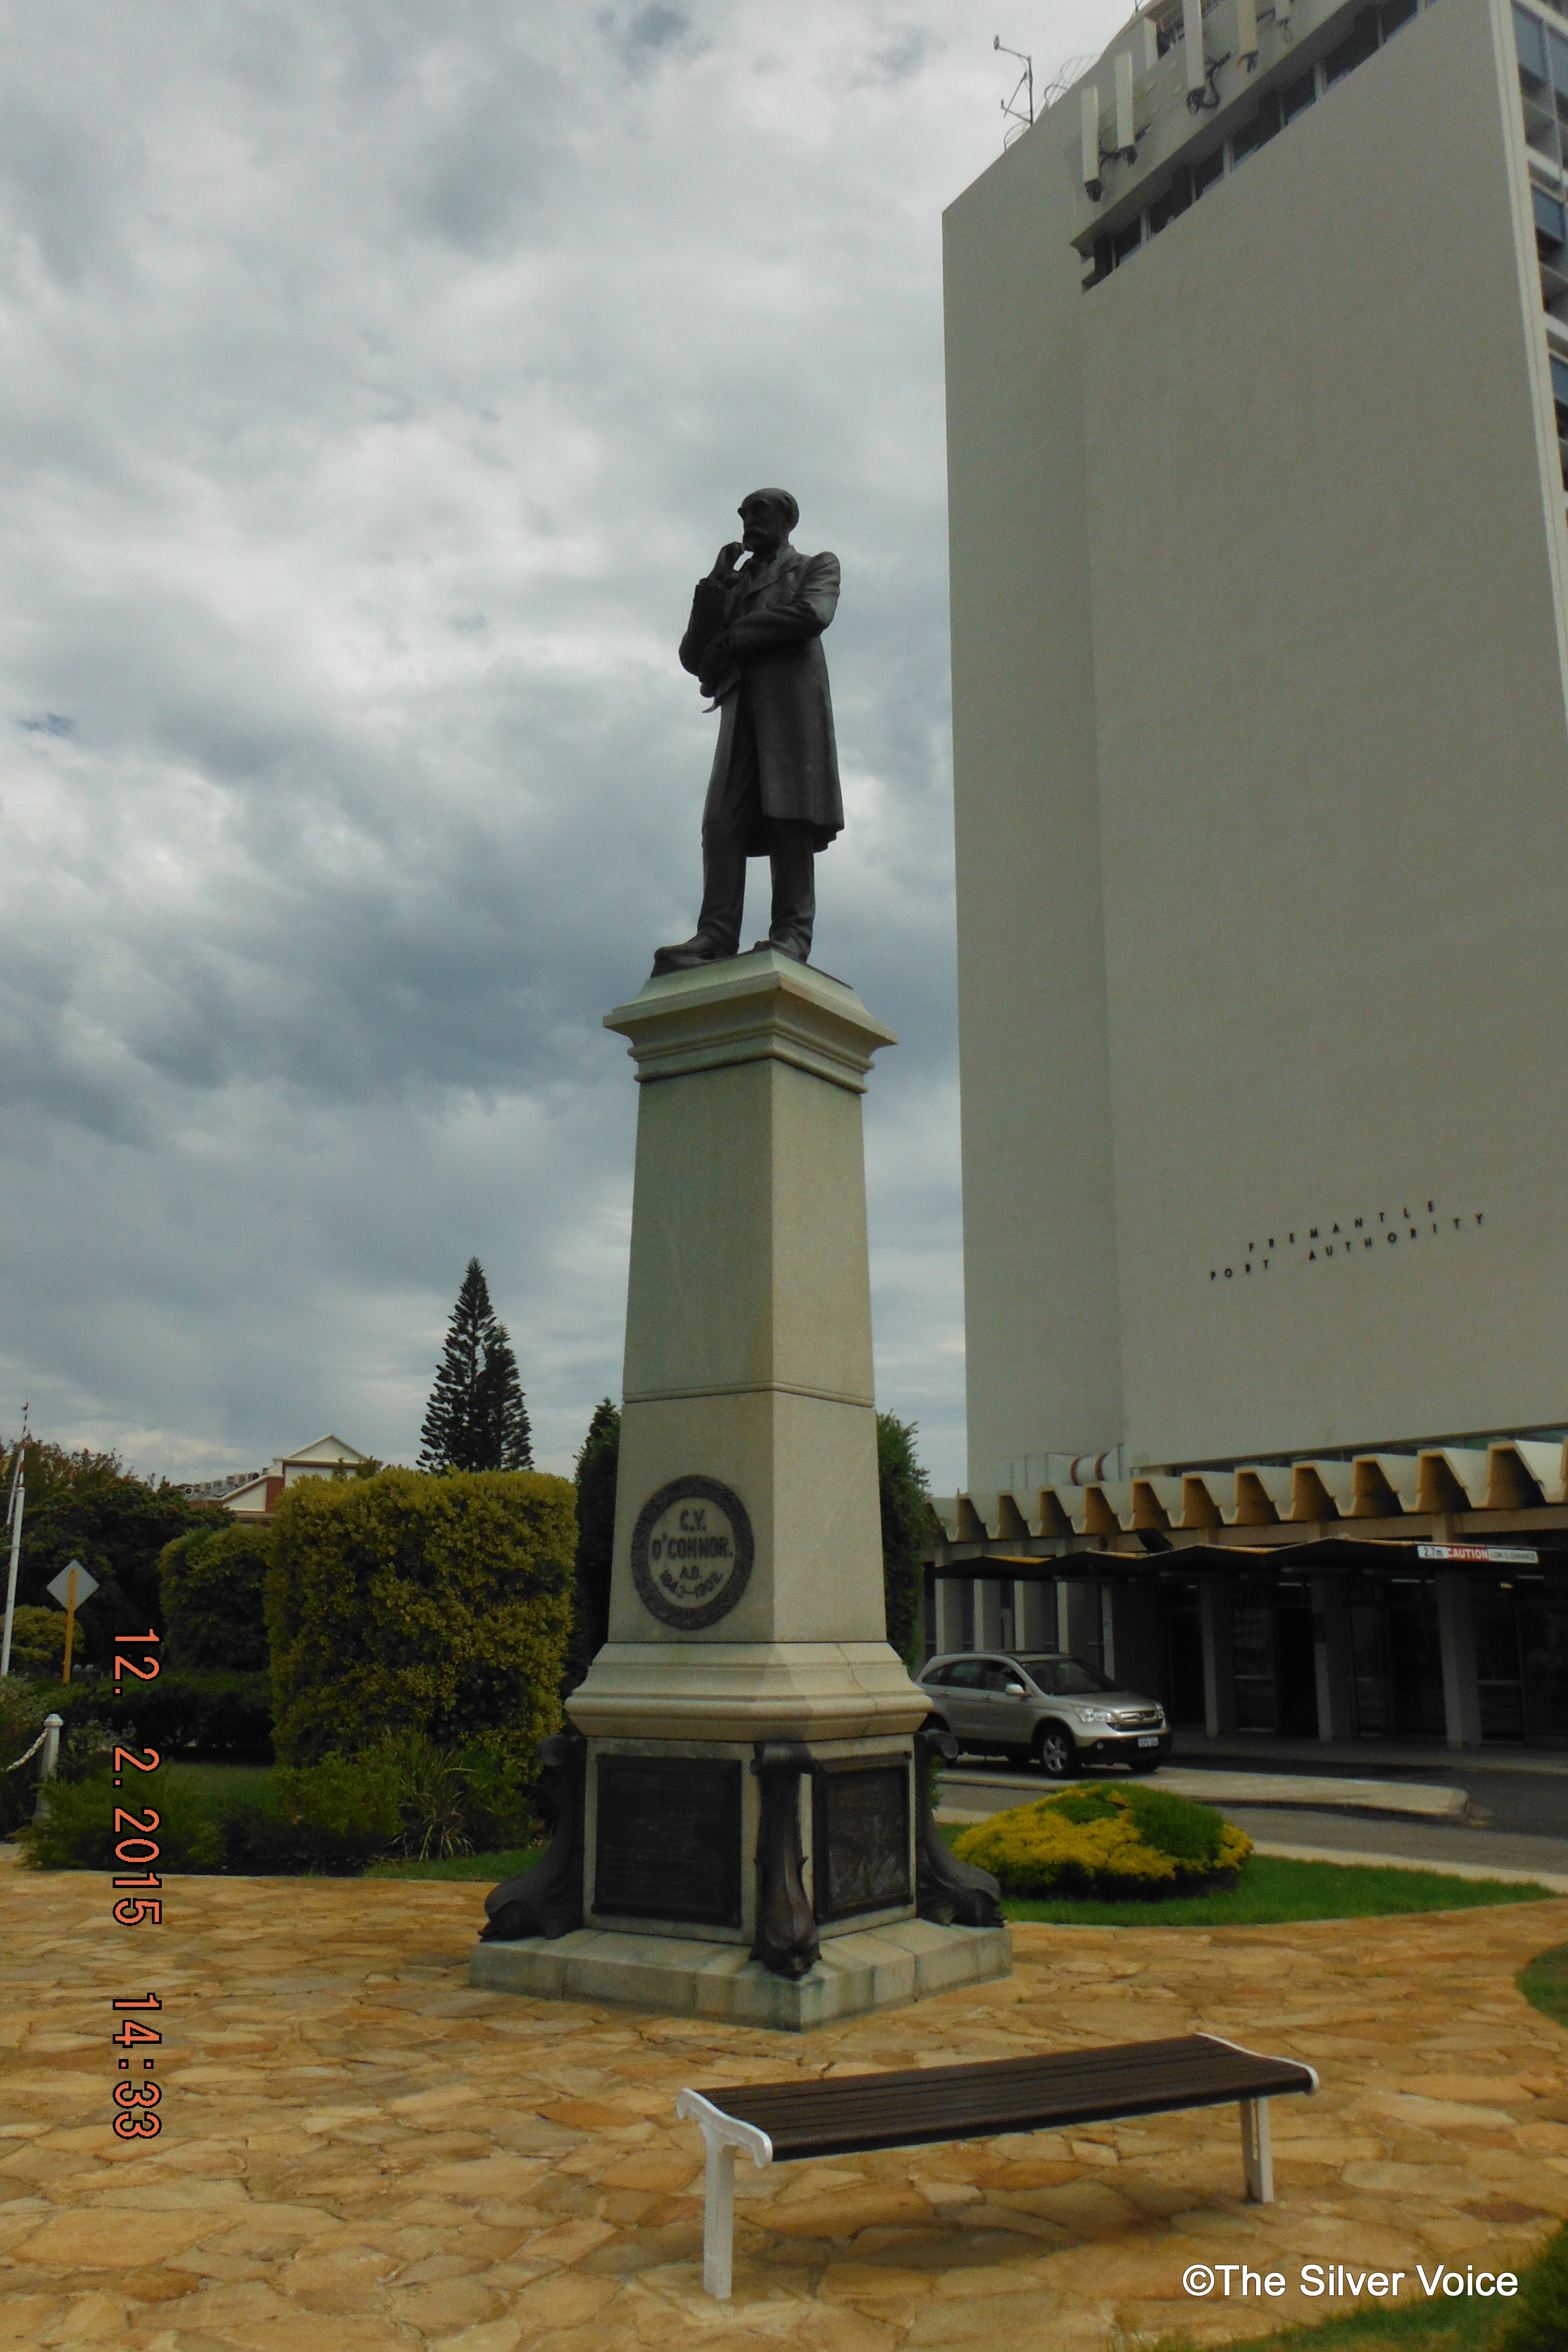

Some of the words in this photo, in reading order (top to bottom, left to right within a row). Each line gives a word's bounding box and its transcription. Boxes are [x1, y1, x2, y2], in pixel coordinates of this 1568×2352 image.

[1210, 1259, 1269, 1280] PORT
[1308, 1213, 1483, 1261] AUTHORITY
[1248, 1200, 1434, 1252] FREMANTLE
[1448, 1547, 1489, 1560] CAUTION
